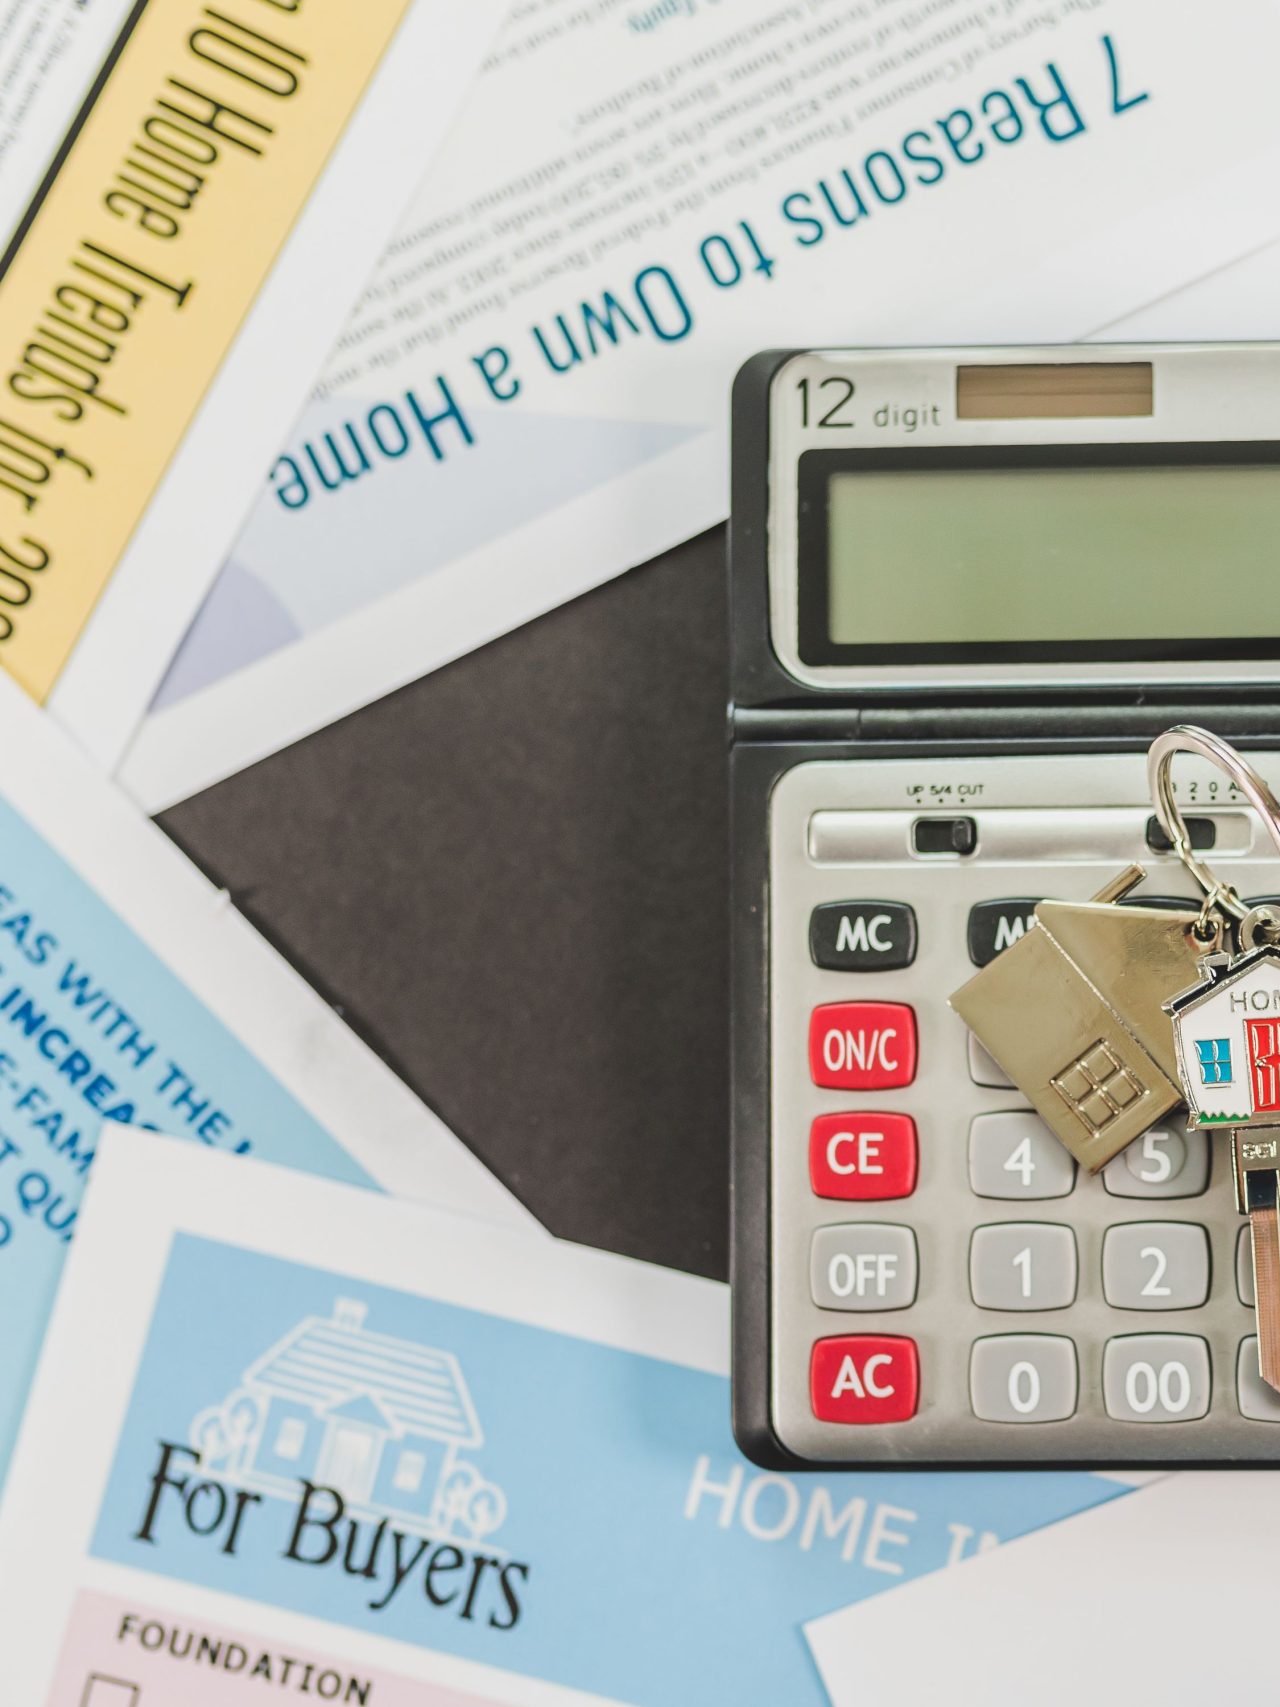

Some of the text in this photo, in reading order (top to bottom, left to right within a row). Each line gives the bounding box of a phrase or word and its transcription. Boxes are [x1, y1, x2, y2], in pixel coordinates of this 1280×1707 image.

[189, 8, 309, 97] 10
[104, 77, 274, 238] Home
[268, 35, 1149, 509] 7 Reasons to Own a Home
[9, 241, 193, 421] Trends
[797, 376, 940, 433] 12 digit
[0, 419, 93, 512] for
[906, 784, 924, 797] UP
[958, 784, 984, 797] CUT
[1189, 782, 1198, 793] 2
[836, 915, 893, 951] MC
[995, 916, 1039, 951] M
[0, 986, 160, 1131] INCREA
[59, 960, 156, 1068] WITH
[155, 1061, 233, 1145] THE
[823, 1029, 898, 1071] ON/C
[826, 1132, 884, 1175] CE
[1003, 1137, 1035, 1186] 4
[1140, 1132, 1171, 1183] 5
[18, 1171, 78, 1243] QU
[828, 1253, 898, 1297] OFF
[1012, 1247, 1031, 1298] 1
[1140, 1247, 1171, 1296] 2
[831, 1354, 895, 1399] AC
[1008, 1361, 1040, 1413] 0
[1125, 1361, 1191, 1413] 00
[133, 1439, 529, 1631] For Buyers
[684, 1454, 918, 1576] HOME
[118, 1612, 374, 1706] FOUNDATION
